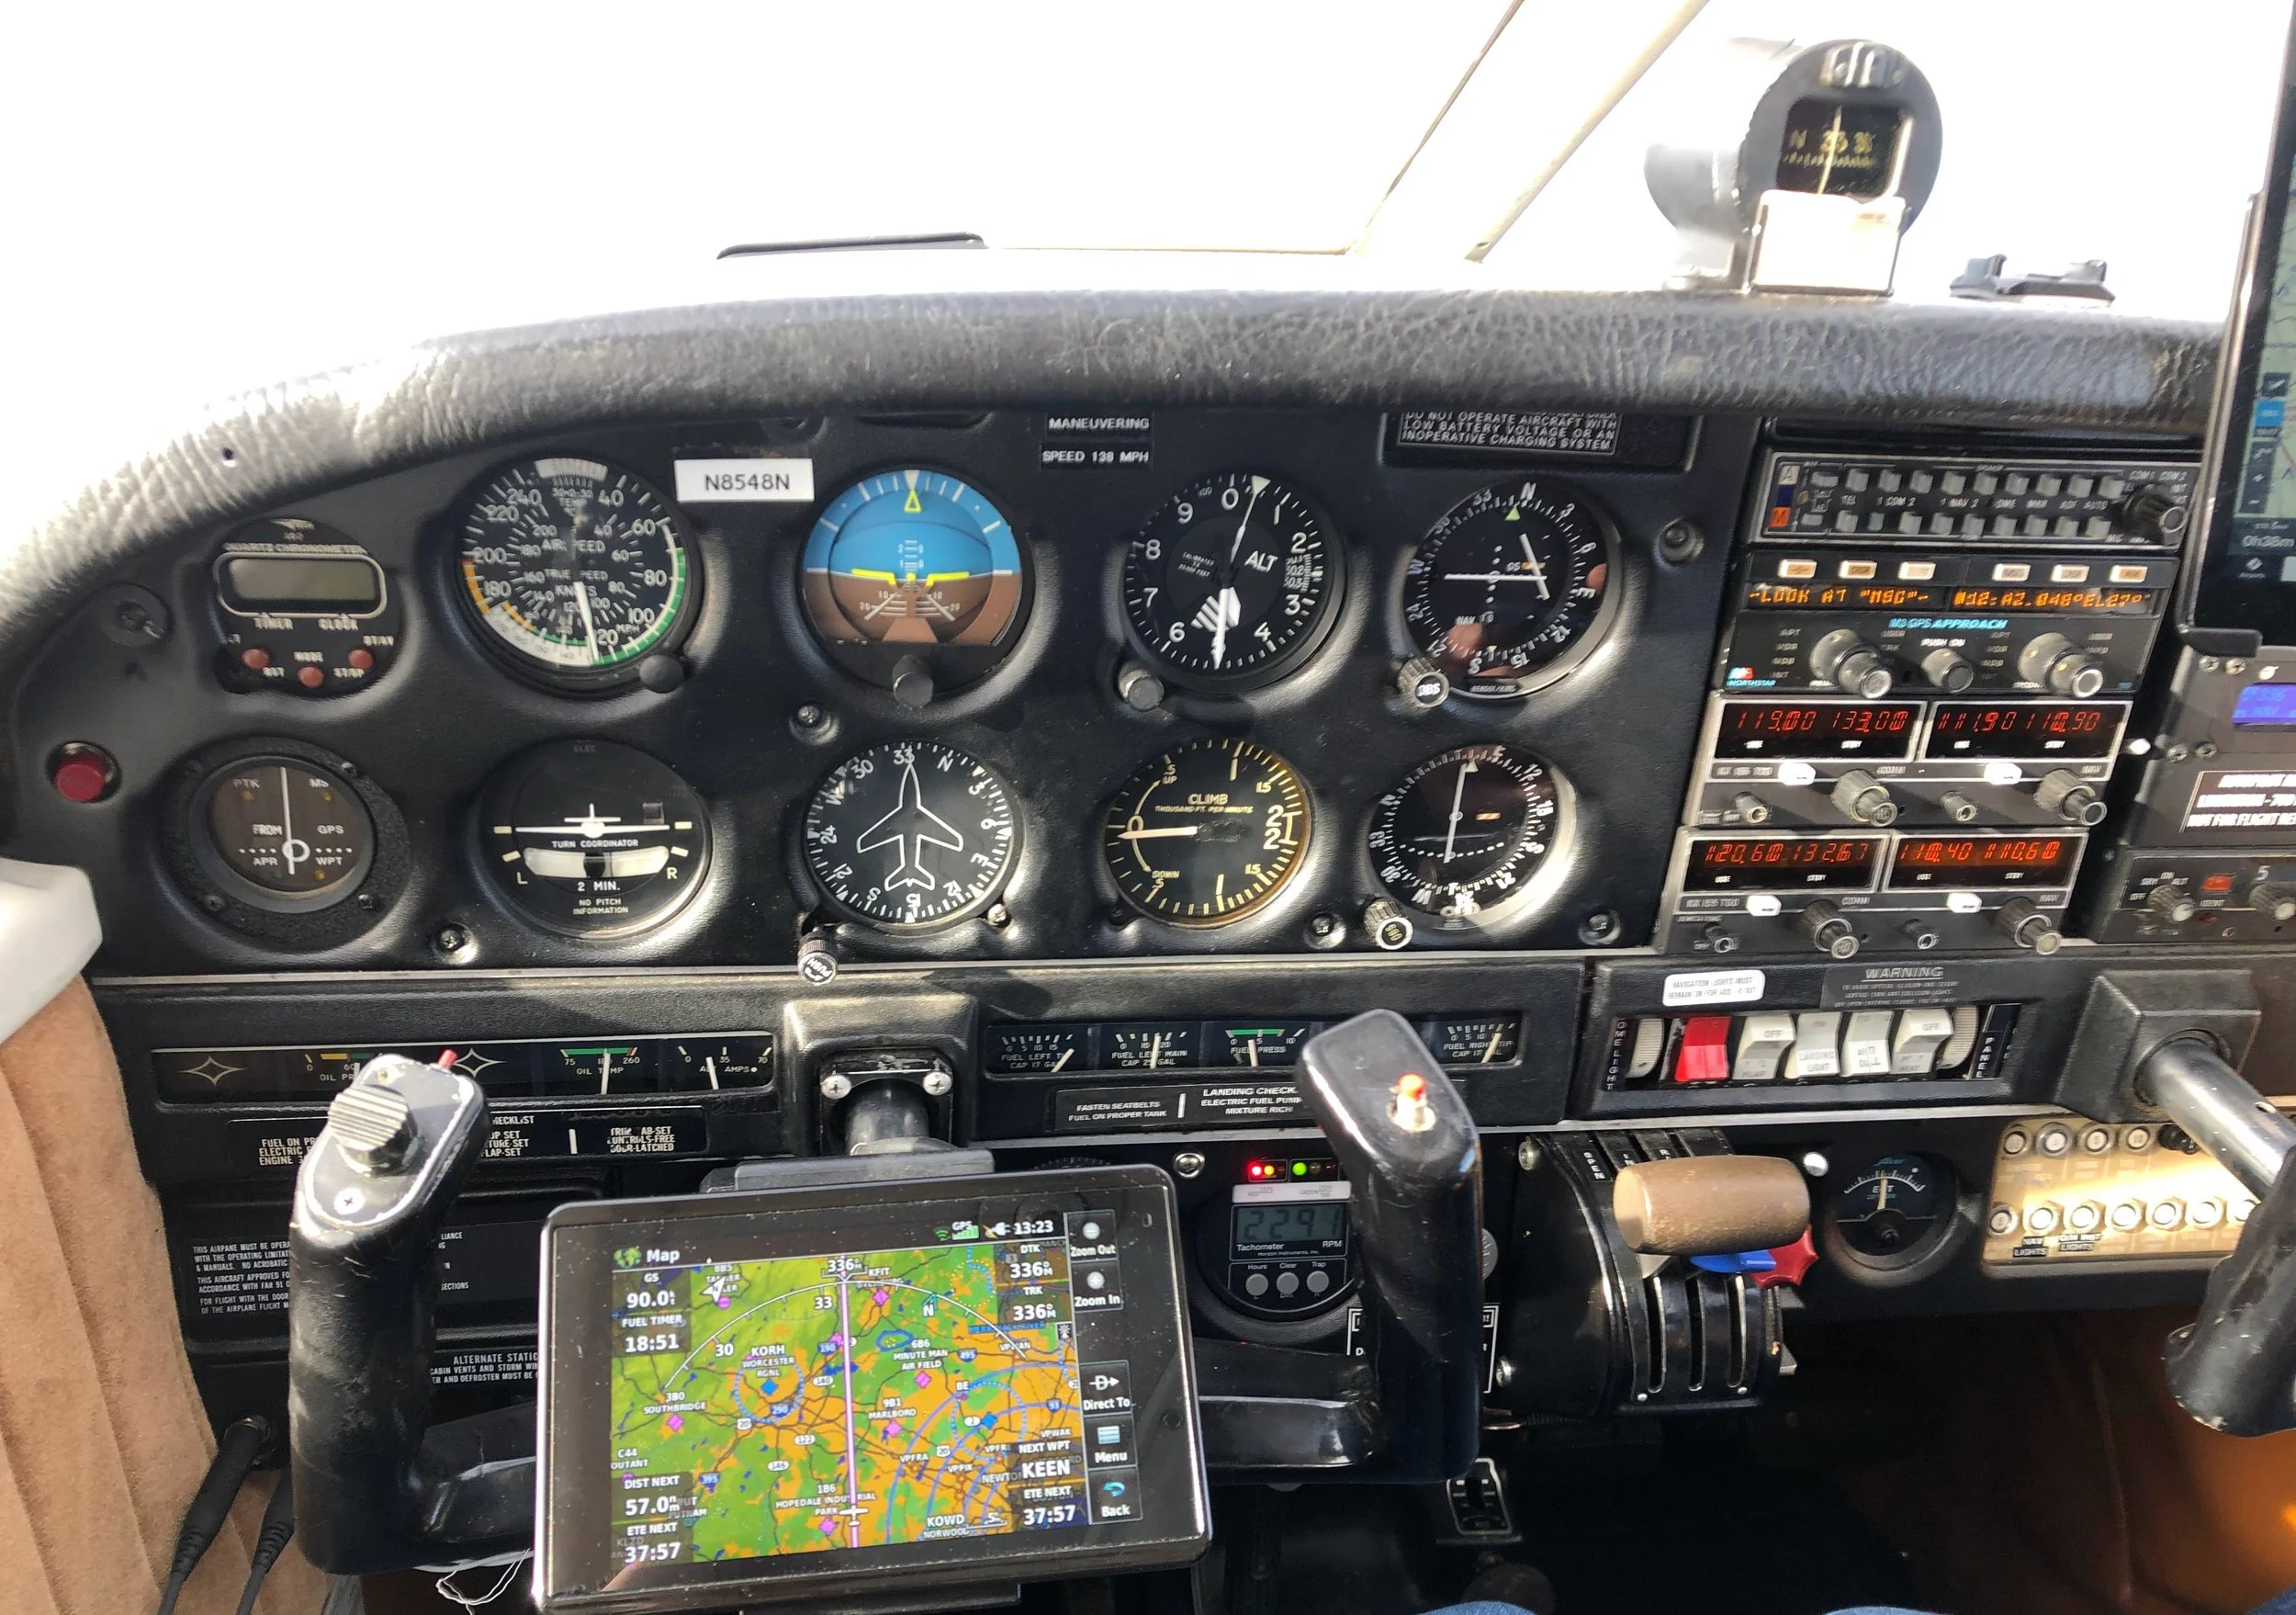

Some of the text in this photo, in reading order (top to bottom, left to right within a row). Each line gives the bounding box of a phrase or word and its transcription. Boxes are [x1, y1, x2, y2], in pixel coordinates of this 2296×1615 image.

[1049, 417, 1149, 430] MANEUVERING
[1459, 412, 1617, 428] OPERATE AIRCRAFT WITH
[1403, 420, 1569, 438] LOW BATTERY VOLTAGE
[1401, 430, 1557, 448] INOPERATIVE CHARGING
[1042, 450, 1149, 463] SPEED 138 MPH
[704, 473, 790, 491] N8548N
[507, 489, 543, 506] 240
[598, 489, 625, 506] 40
[1521, 482, 1536, 501] N
[1221, 488, 1239, 510] 0
[486, 504, 519, 523] 220
[1177, 503, 1193, 524] 9
[631, 518, 656, 536] 60
[1146, 538, 1161, 560] 8
[1291, 532, 1307, 553] 2
[473, 548, 506, 564] 200
[1244, 551, 1277, 572] ALT
[644, 570, 667, 587] 80
[484, 581, 512, 597] 180
[1144, 588, 1158, 607] 7
[1285, 594, 1300, 616] 3
[628, 608, 655, 625] 100
[616, 623, 640, 634] MPH
[1931, 619, 2008, 628] APPROACH
[1169, 622, 1185, 642] 6
[1254, 622, 1271, 641] 4
[1416, 683, 1441, 696] OBS
[893, 749, 915, 764] 33
[937, 754, 953, 772] N
[851, 760, 873, 779] 30
[1163, 776, 1177, 785] UP
[1188, 794, 1229, 805] CLIMB
[1266, 805, 1284, 826] 2
[317, 825, 343, 834] GPS
[552, 840, 638, 848] TURN COORDINATOR
[1263, 828, 1280, 849] 2
[253, 857, 277, 866] APR
[315, 856, 343, 865] WPT
[517, 872, 528, 884] L
[667, 867, 677, 879] R
[578, 881, 621, 892] 2 MIN.
[573, 907, 628, 915] INFORMATION
[1385, 924, 1402, 941] OBS
[806, 958, 833, 977] PUSH
[1866, 967, 1943, 978] WARNING
[1976, 1037, 1995, 1078] PANEL
[599, 1067, 624, 1075] TMP
[1807, 1063, 1830, 1071] LIGHT
[1203, 1088, 1254, 1096] LANDING
[1077, 1101, 1160, 1112] FASTEN SEATBELTS
[262, 1138, 299, 1147] FUEL ON
[259, 1146, 303, 1157] ELECTRIC
[259, 1156, 293, 1165] ENGINE
[1014, 1220, 1054, 1235] 13:23
[1020, 1245, 1041, 1254] DTK
[1070, 1244, 1116, 1257] Zoom Out
[1237, 1240, 1342, 1252] Tachometer RPM
[228, 1252, 263, 1260] OPERATING
[647, 1249, 681, 1263] Map
[247, 1272, 280, 1281] APPROVED
[644, 1273, 659, 1282] GS
[198, 1284, 240, 1293] ACCORDANCE
[1023, 1286, 1043, 1295] TRK
[815, 1296, 833, 1310] 33
[1075, 1296, 1107, 1307] Zoom
[622, 1316, 682, 1327] FUEL TIMER
[625, 1334, 679, 1352] 18:51
[715, 1343, 734, 1357] 30
[751, 1345, 785, 1356] KORH
[893, 1350, 949, 1361] MINUTE MAN
[454, 1353, 502, 1365] ALTERNATE
[742, 1355, 794, 1369] WORCESTER
[920, 1360, 942, 1369] FIELD
[454, 1365, 477, 1373] VENTS
[479, 1364, 494, 1372] AND
[444, 1372, 522, 1383] AND DEFROSTER MUST
[644, 1401, 706, 1414] SOUTHBRIDGE
[1084, 1397, 1131, 1410] Direct To
[868, 1409, 917, 1419] MARLBORO
[1019, 1440, 1071, 1453] NEXT WPT
[1095, 1452, 1127, 1463] Menu
[1022, 1460, 1071, 1478] KEEN
[625, 1475, 681, 1489] DIST NEXT
[1024, 1486, 1072, 1499] ETE NEXT
[776, 1497, 821, 1508] HOPEDALE
[1023, 1505, 1076, 1526] 37:57
[1102, 1505, 1131, 1518] Back
[928, 1516, 964, 1527] KOWD
[626, 1522, 678, 1536] ETE NEXT
[625, 1542, 681, 1563] 37:57
